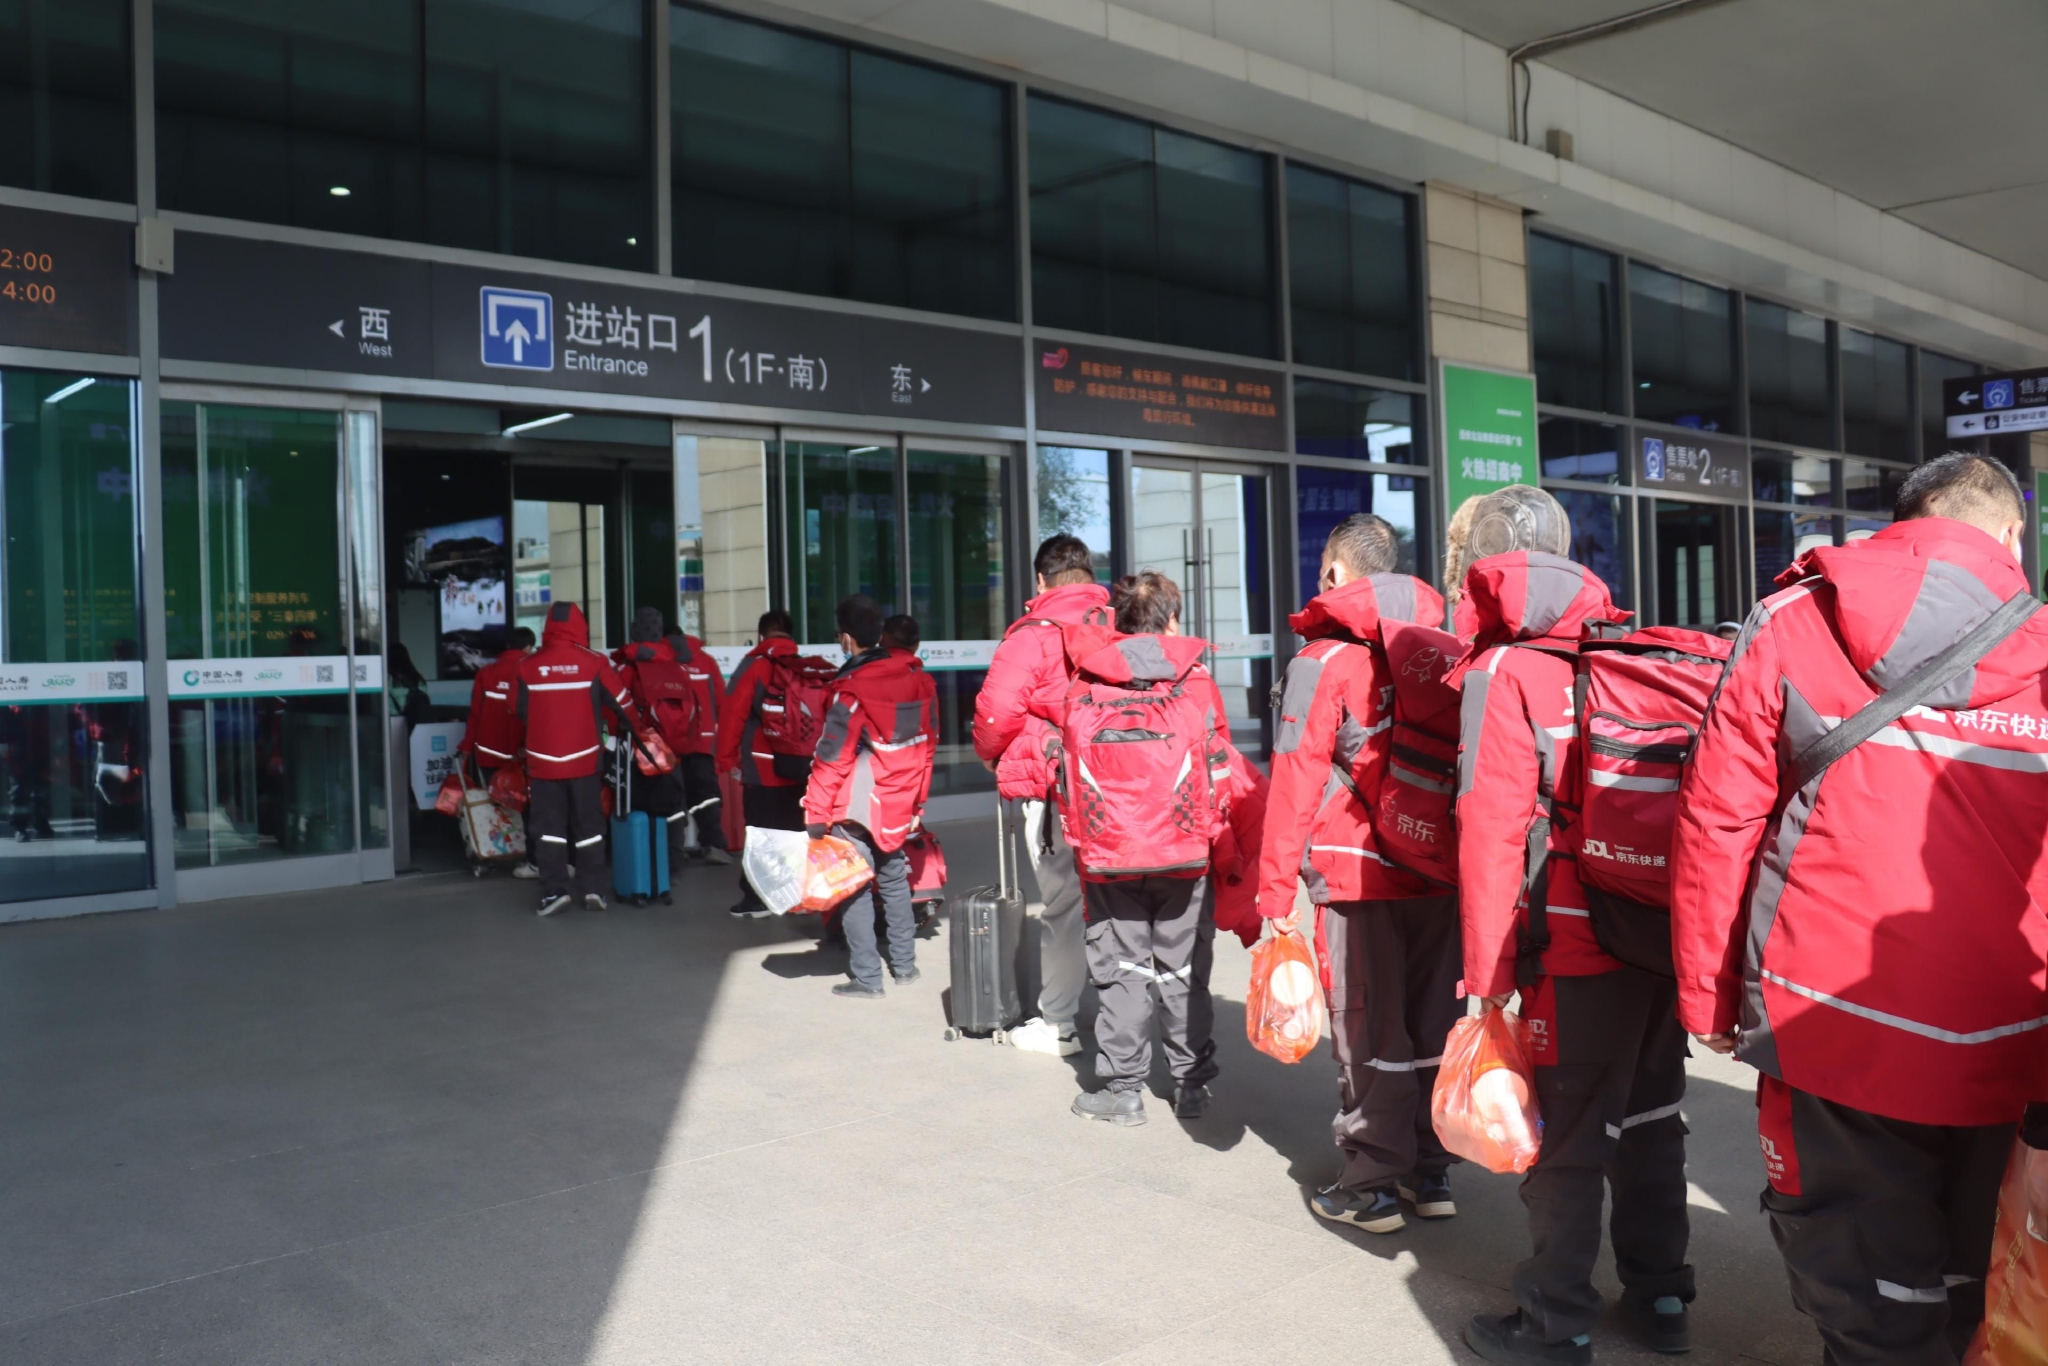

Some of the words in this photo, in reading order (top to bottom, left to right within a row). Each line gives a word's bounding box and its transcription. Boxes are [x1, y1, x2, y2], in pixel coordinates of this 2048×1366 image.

[2, 281, 56, 304] 4:00
[359, 306, 391, 341] 西
[358, 341, 393, 358] West
[565, 301, 678, 352] 进站口
[689, 315, 713, 383] 1
[564, 349, 649, 377] Entrance
[890, 363, 912, 391] 东
[1698, 448, 1712, 487] 2
[202, 670, 243, 679] 中国人寿
[1397, 812, 1437, 844] 京东
[1582, 838, 1615, 860] JDL
[1615, 851, 1666, 867] 京东快递
